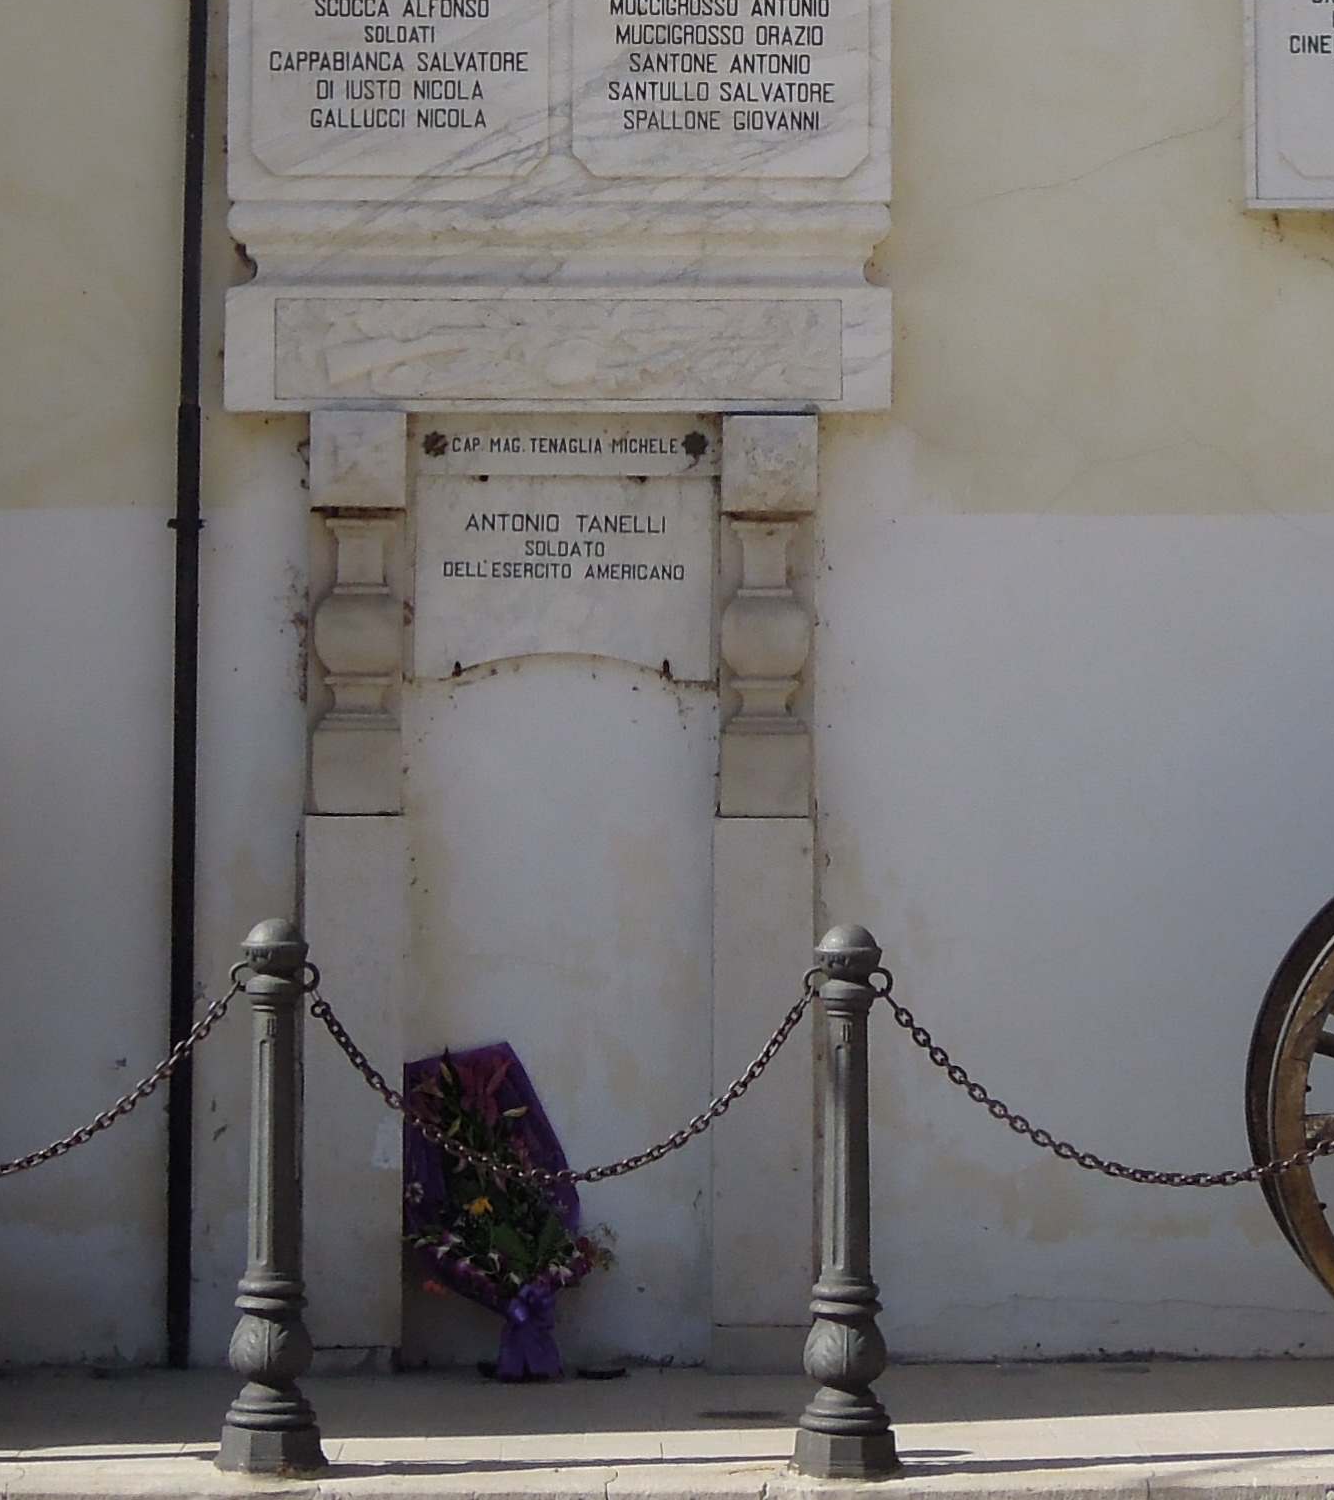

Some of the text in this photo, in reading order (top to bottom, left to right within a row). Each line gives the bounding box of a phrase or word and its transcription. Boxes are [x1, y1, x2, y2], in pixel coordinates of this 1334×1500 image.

[364, 25, 435, 44] SOLDATI
[615, 23, 824, 47] MUCCIGROSSO ORAZIO
[269, 50, 529, 72] CAPPABIANCA SALVATORE
[629, 52, 811, 75] SANTONE ANTONIO
[316, 79, 484, 101] DI IUSTO NICOLA
[608, 80, 835, 104] SANTULLO SALVATORE
[310, 107, 487, 129] GALLUCCI NICOLA
[623, 109, 820, 131] SPALLONE GIOVANNI
[489, 436, 526, 453] MAG.
[529, 437, 603, 455] TENAGLIA
[611, 437, 679, 455] MICHELE
[465, 513, 666, 534] ANTONIO TANELLI
[524, 541, 605, 558] SOLDATO
[584, 564, 685, 581] AMERICANO
